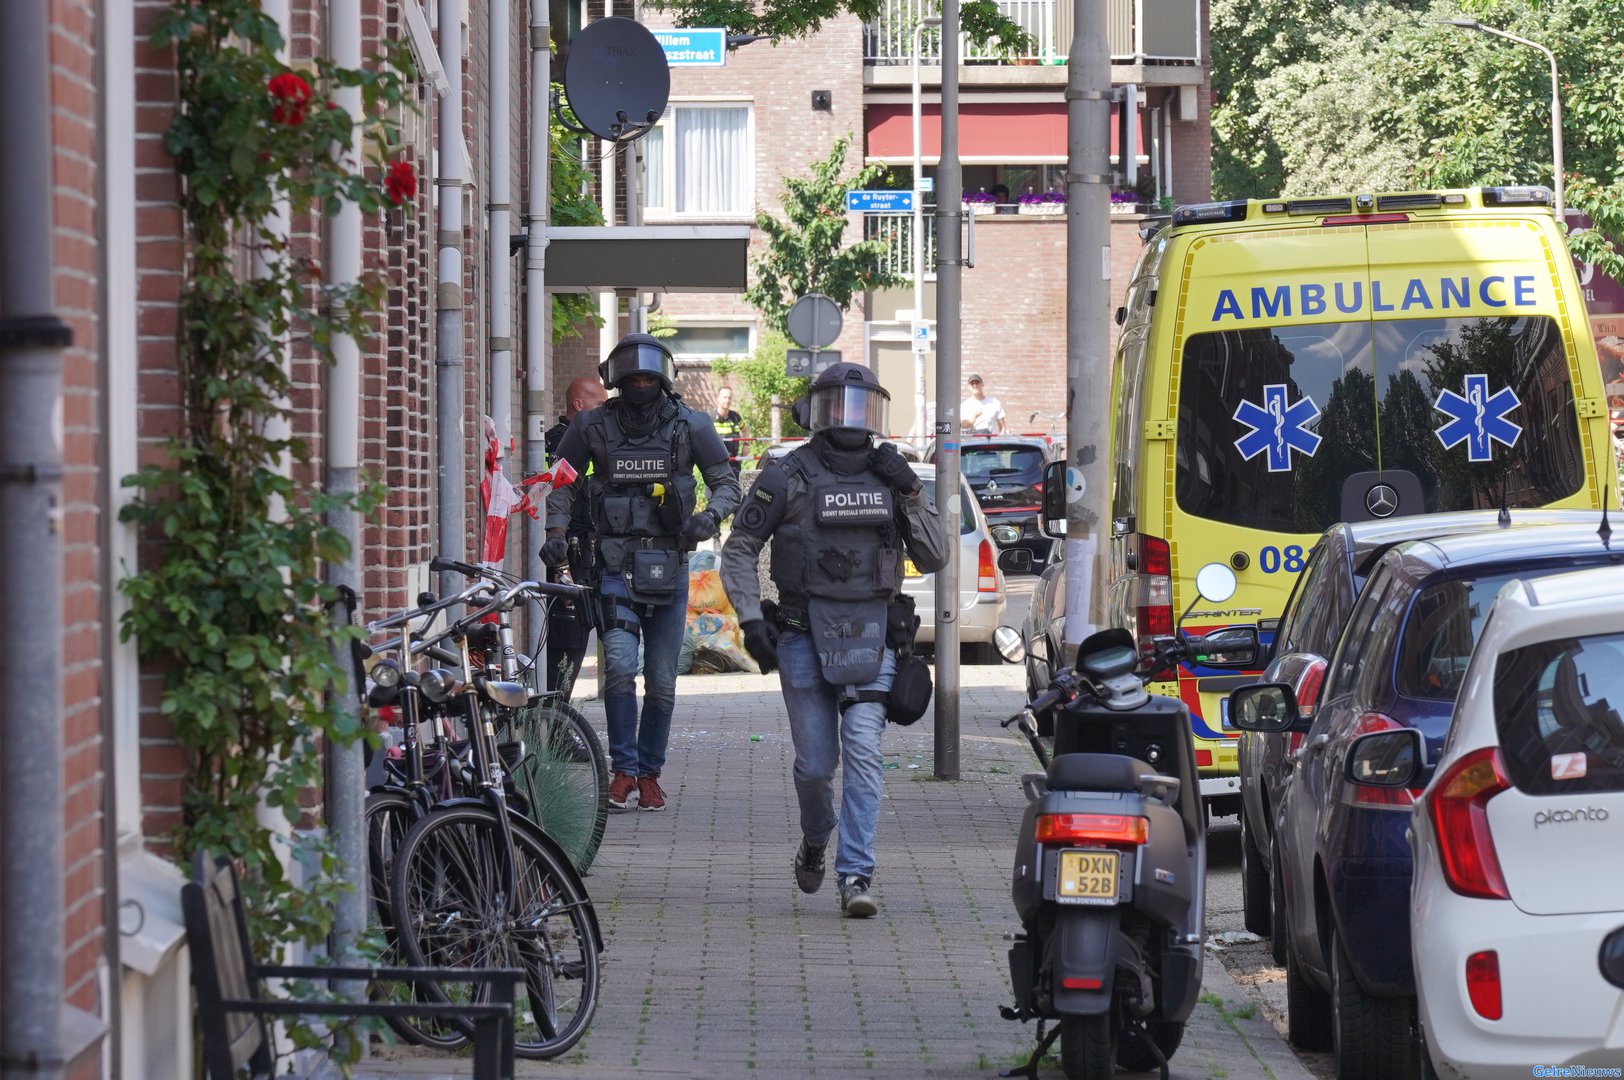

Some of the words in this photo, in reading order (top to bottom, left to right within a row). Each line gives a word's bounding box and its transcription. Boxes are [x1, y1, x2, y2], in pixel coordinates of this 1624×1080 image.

[606, 46, 637, 57] TRIAX
[665, 49, 715, 60] szstraat
[873, 193, 899, 202] Ruyter-
[1211, 275, 1537, 322] AMBULANCE
[616, 460, 665, 471] POLITIE
[755, 489, 773, 502] MEDIC
[825, 493, 883, 507] POLITIE
[838, 509, 858, 517] SPECIALE
[859, 508, 888, 516] INTERVENTIES
[1259, 545, 1314, 573] 08
[1183, 608, 1262, 619] SPRINTER
[1534, 805, 1609, 829] picanto
[1079, 857, 1113, 874] DXN
[1078, 877, 1112, 894] 52B
